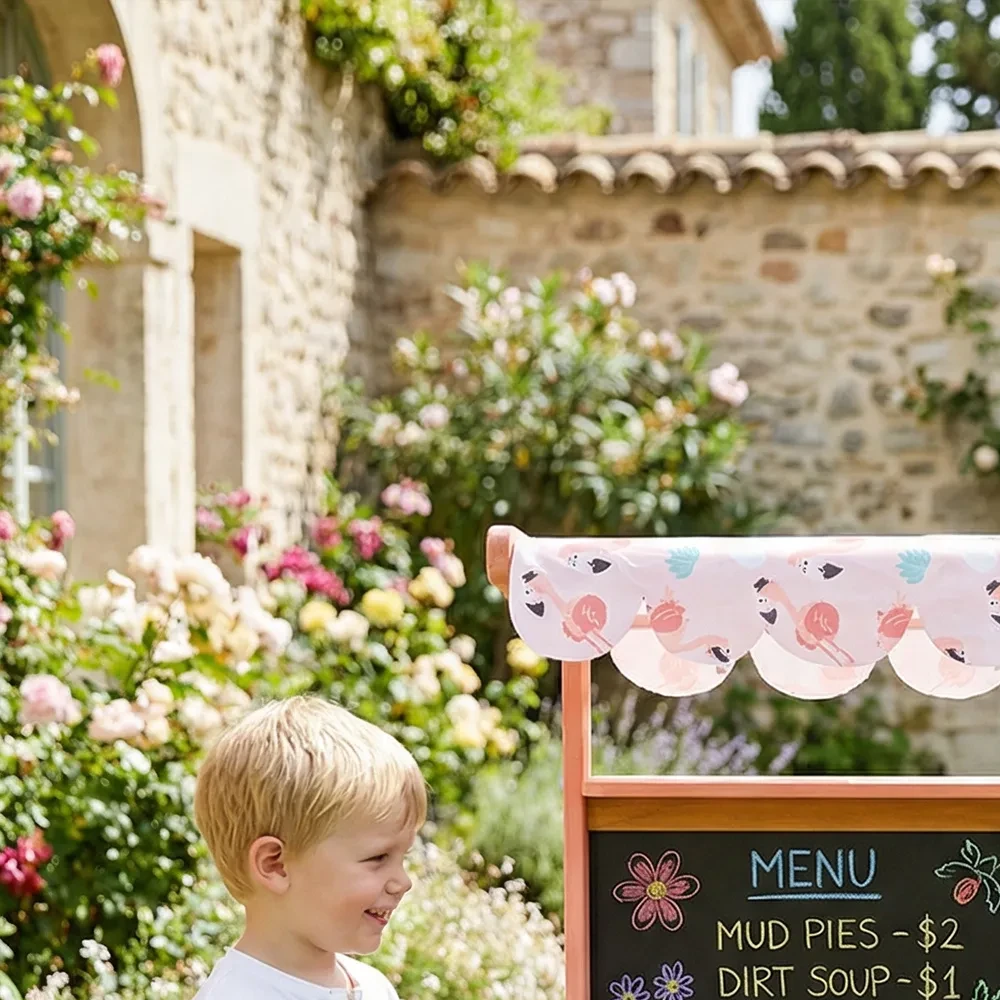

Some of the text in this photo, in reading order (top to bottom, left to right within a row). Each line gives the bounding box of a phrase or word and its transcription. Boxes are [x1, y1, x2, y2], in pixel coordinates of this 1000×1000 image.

[751, 848, 876, 889] MENU
[717, 918, 789, 951] MUD
[805, 917, 879, 950] PIES
[917, 913, 964, 954] $2
[718, 965, 795, 998] DIRT
